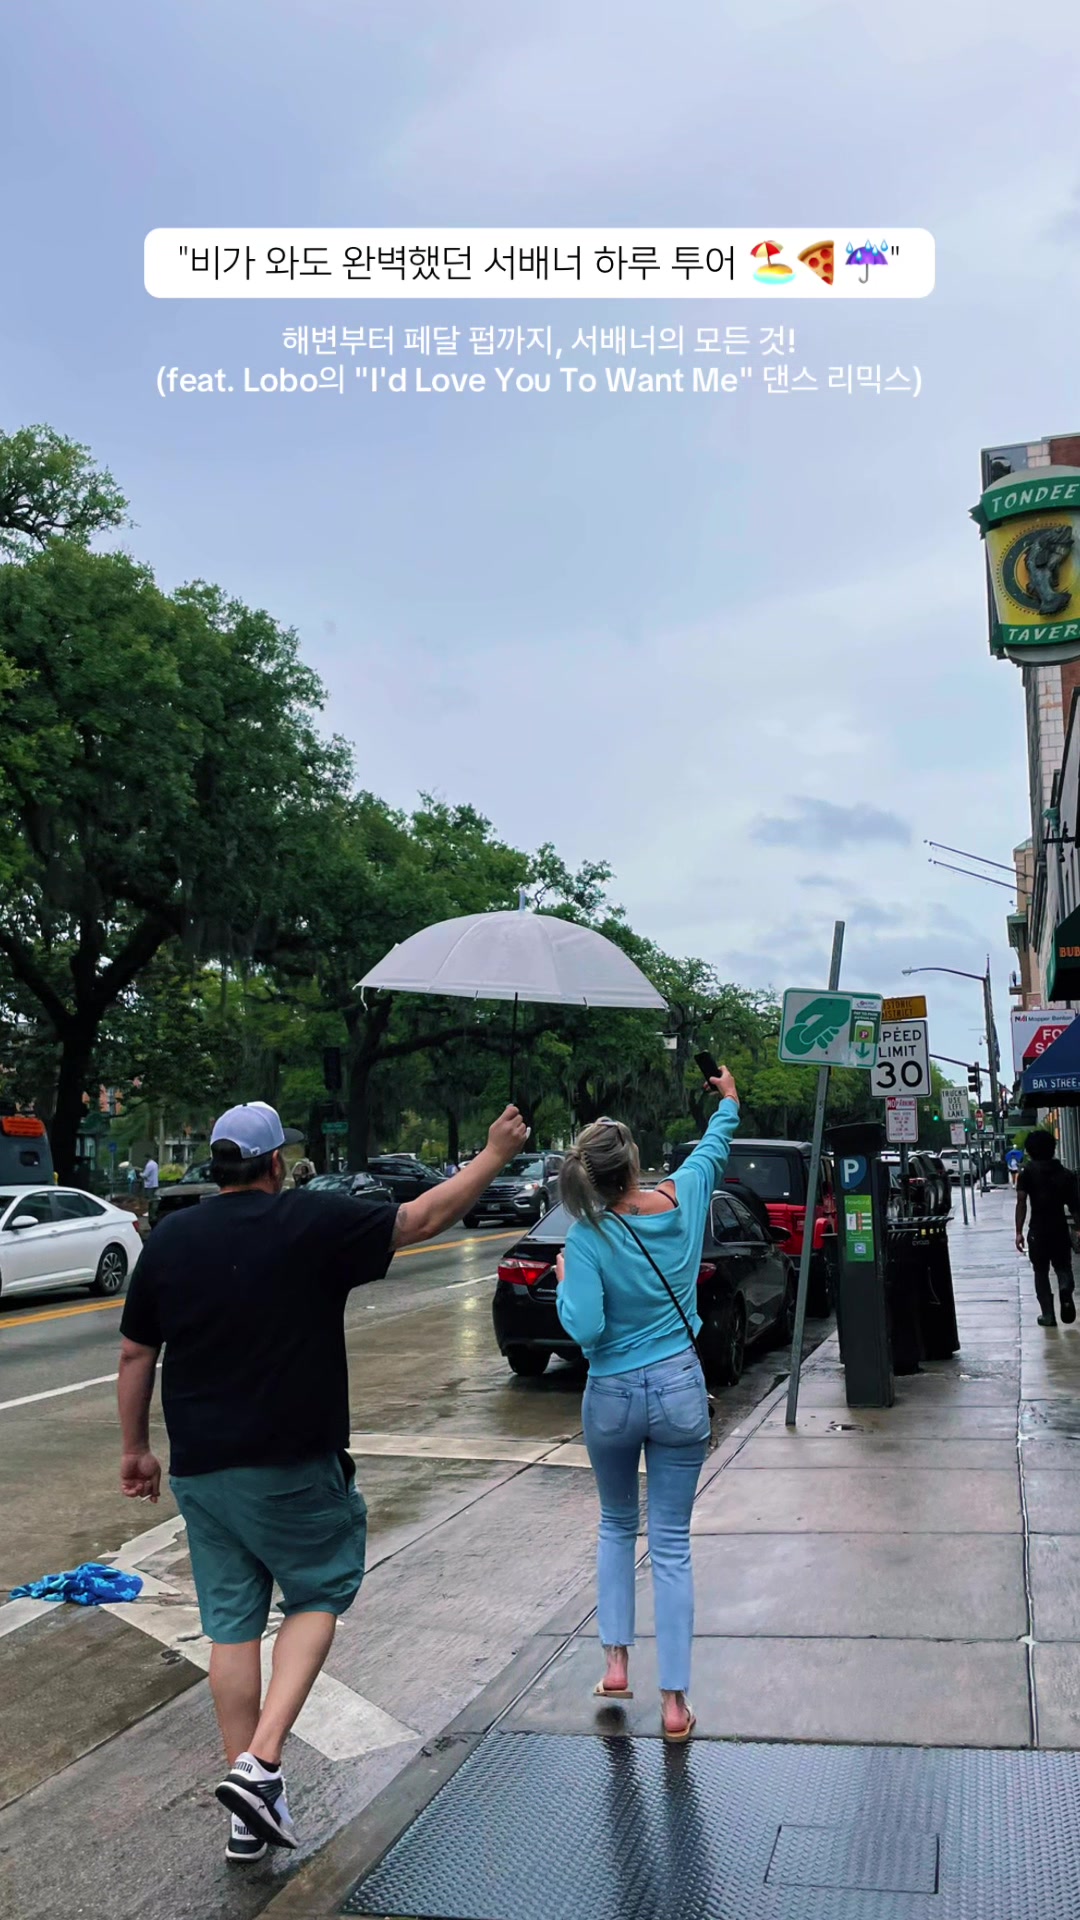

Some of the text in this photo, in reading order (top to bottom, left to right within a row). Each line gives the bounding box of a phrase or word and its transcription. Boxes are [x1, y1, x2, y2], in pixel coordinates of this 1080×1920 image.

[991, 483, 1080, 514] TONDEE
[1008, 623, 1080, 642] TAVER
[883, 1000, 912, 1010] ISTORIC
[878, 1029, 921, 1042] PEED
[1042, 1028, 1065, 1041] FO
[878, 1045, 916, 1058] LIMIT
[876, 1060, 922, 1088] 30
[1032, 1078, 1080, 1089] BAY STREE
[948, 1110, 965, 1118] LANE
[844, 1159, 859, 1183] P
[234, 1824, 251, 1836] PUM
